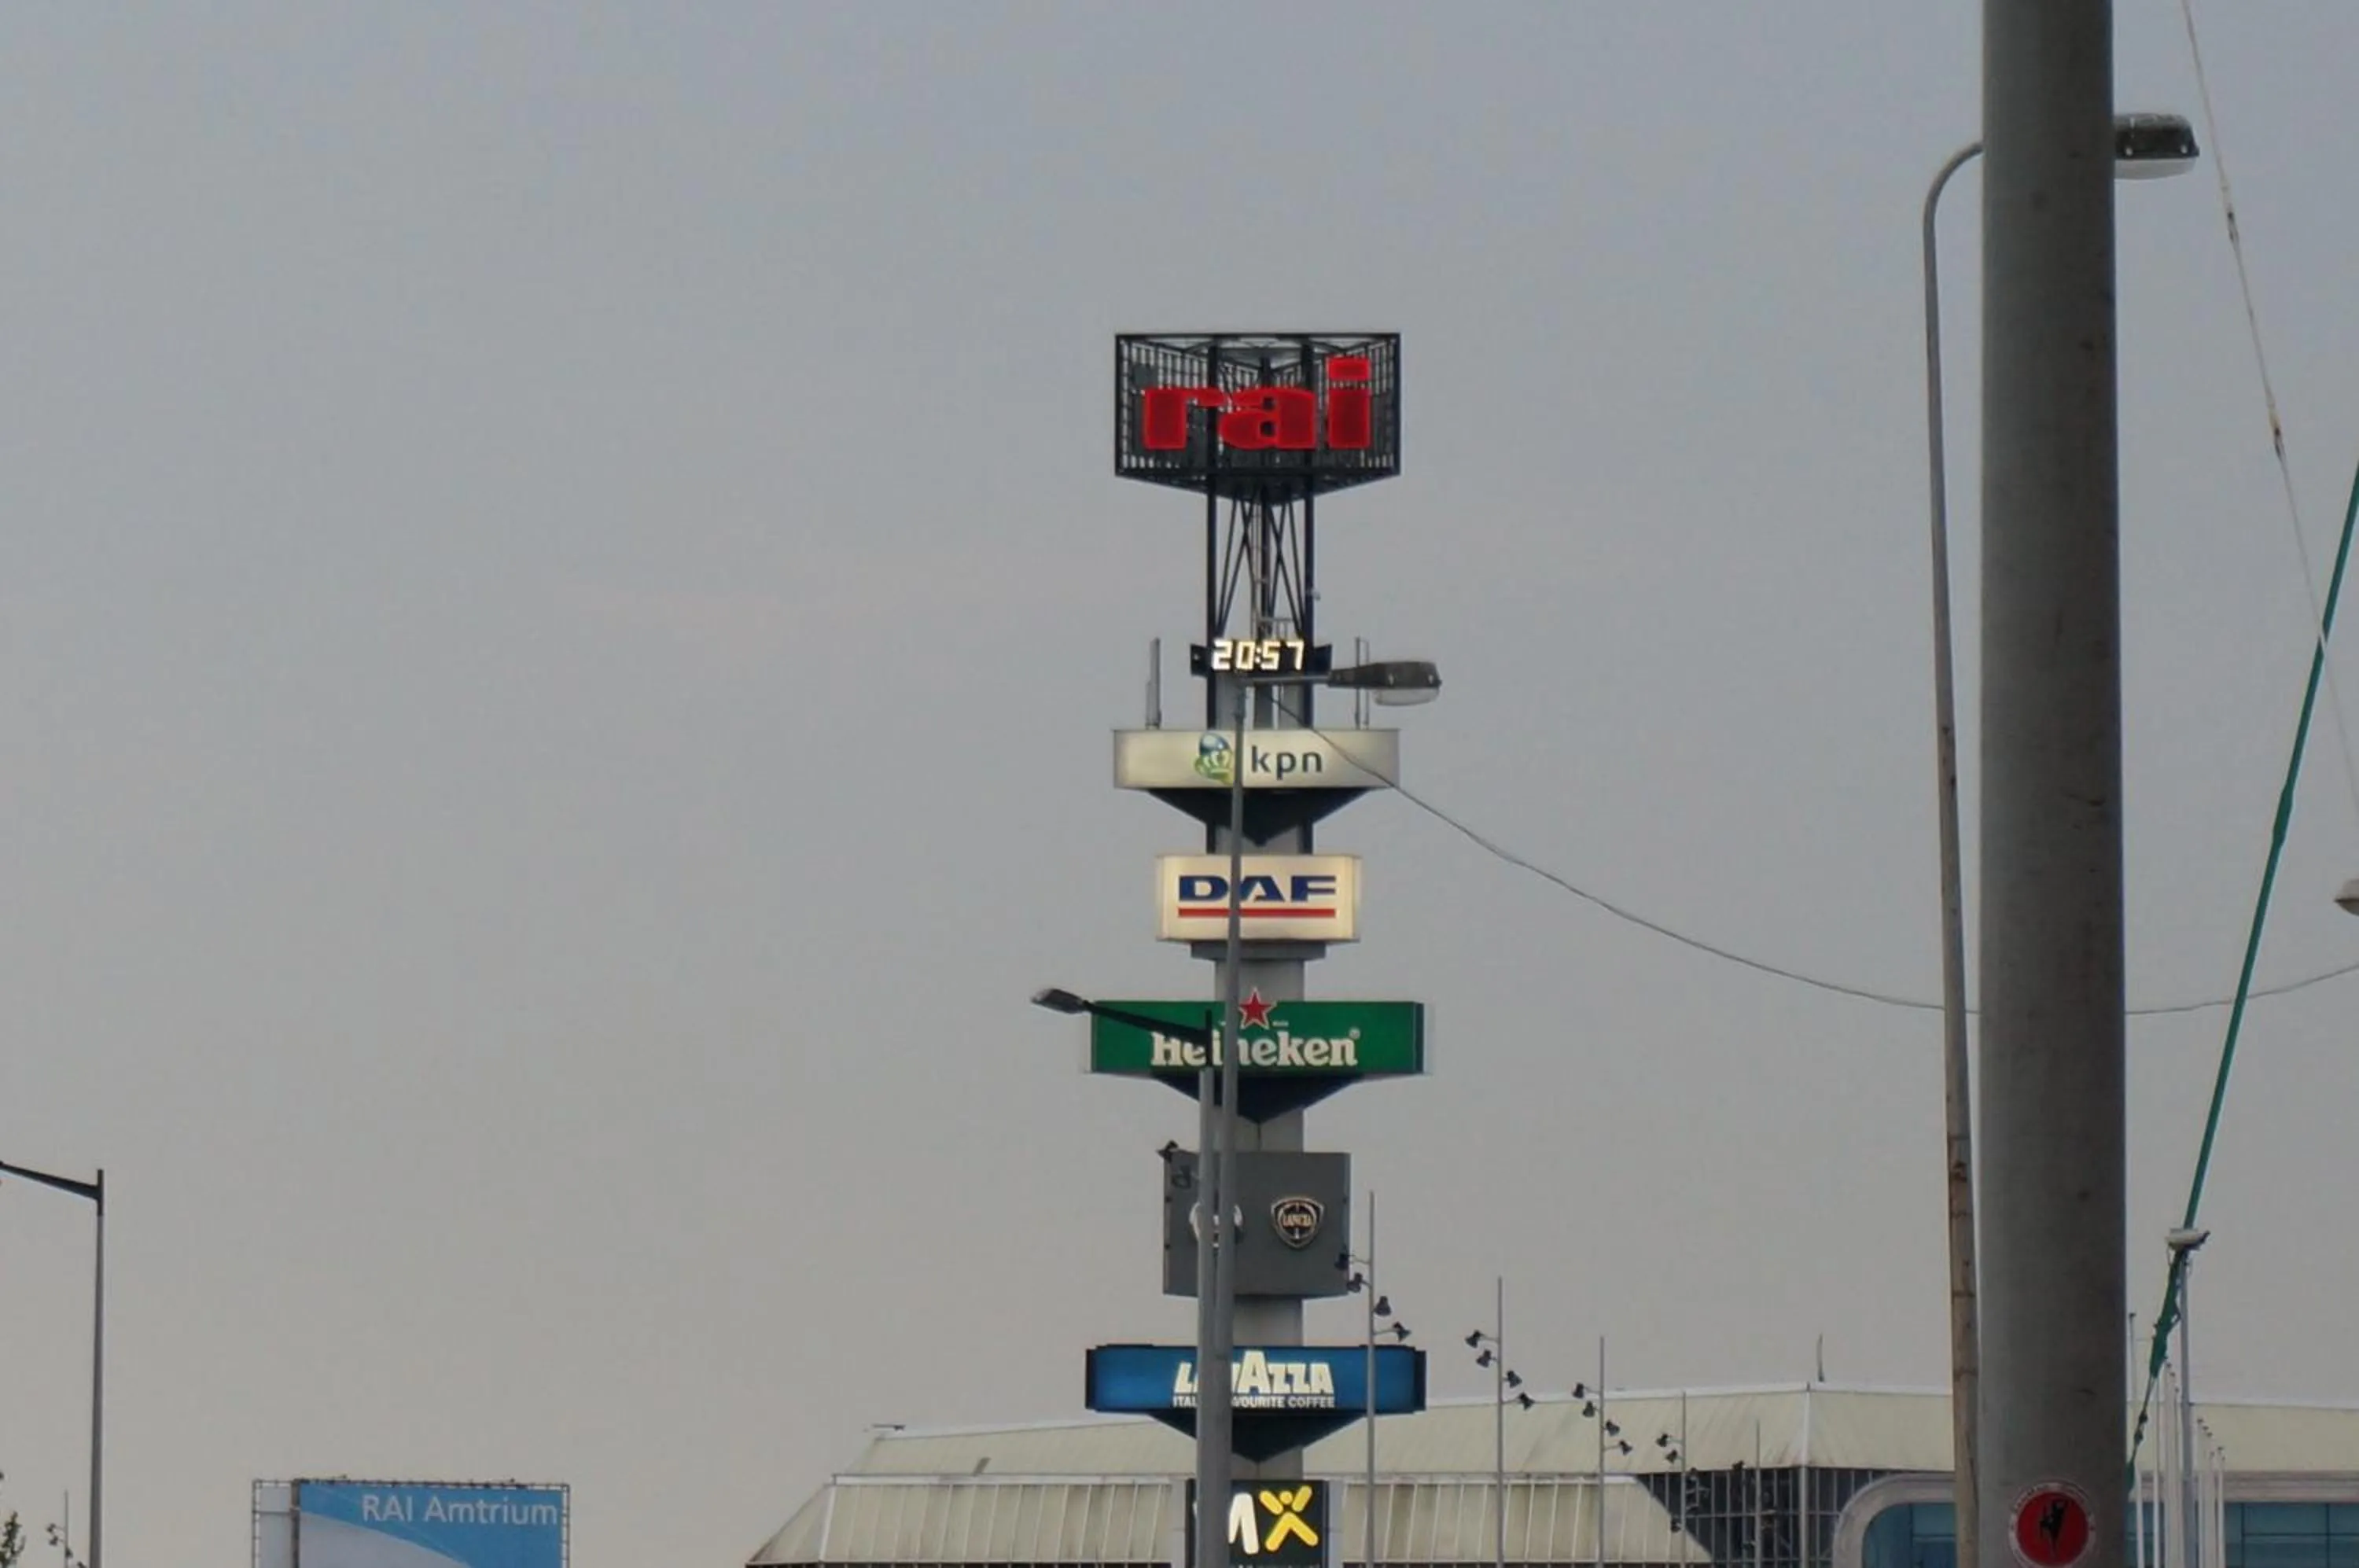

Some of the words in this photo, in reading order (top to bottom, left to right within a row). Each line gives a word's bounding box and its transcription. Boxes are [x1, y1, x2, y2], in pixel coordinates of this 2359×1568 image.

[1143, 356, 1371, 450] rai
[1212, 639, 1305, 671] 20:57
[1251, 745, 1323, 779] kpn
[1179, 875, 1336, 902] DAF
[1174, 1349, 1335, 1394] LAZZA
[1288, 1395, 1336, 1408] COFFEE
[362, 1495, 414, 1522] RAI
[423, 1496, 558, 1525] Amtrium
